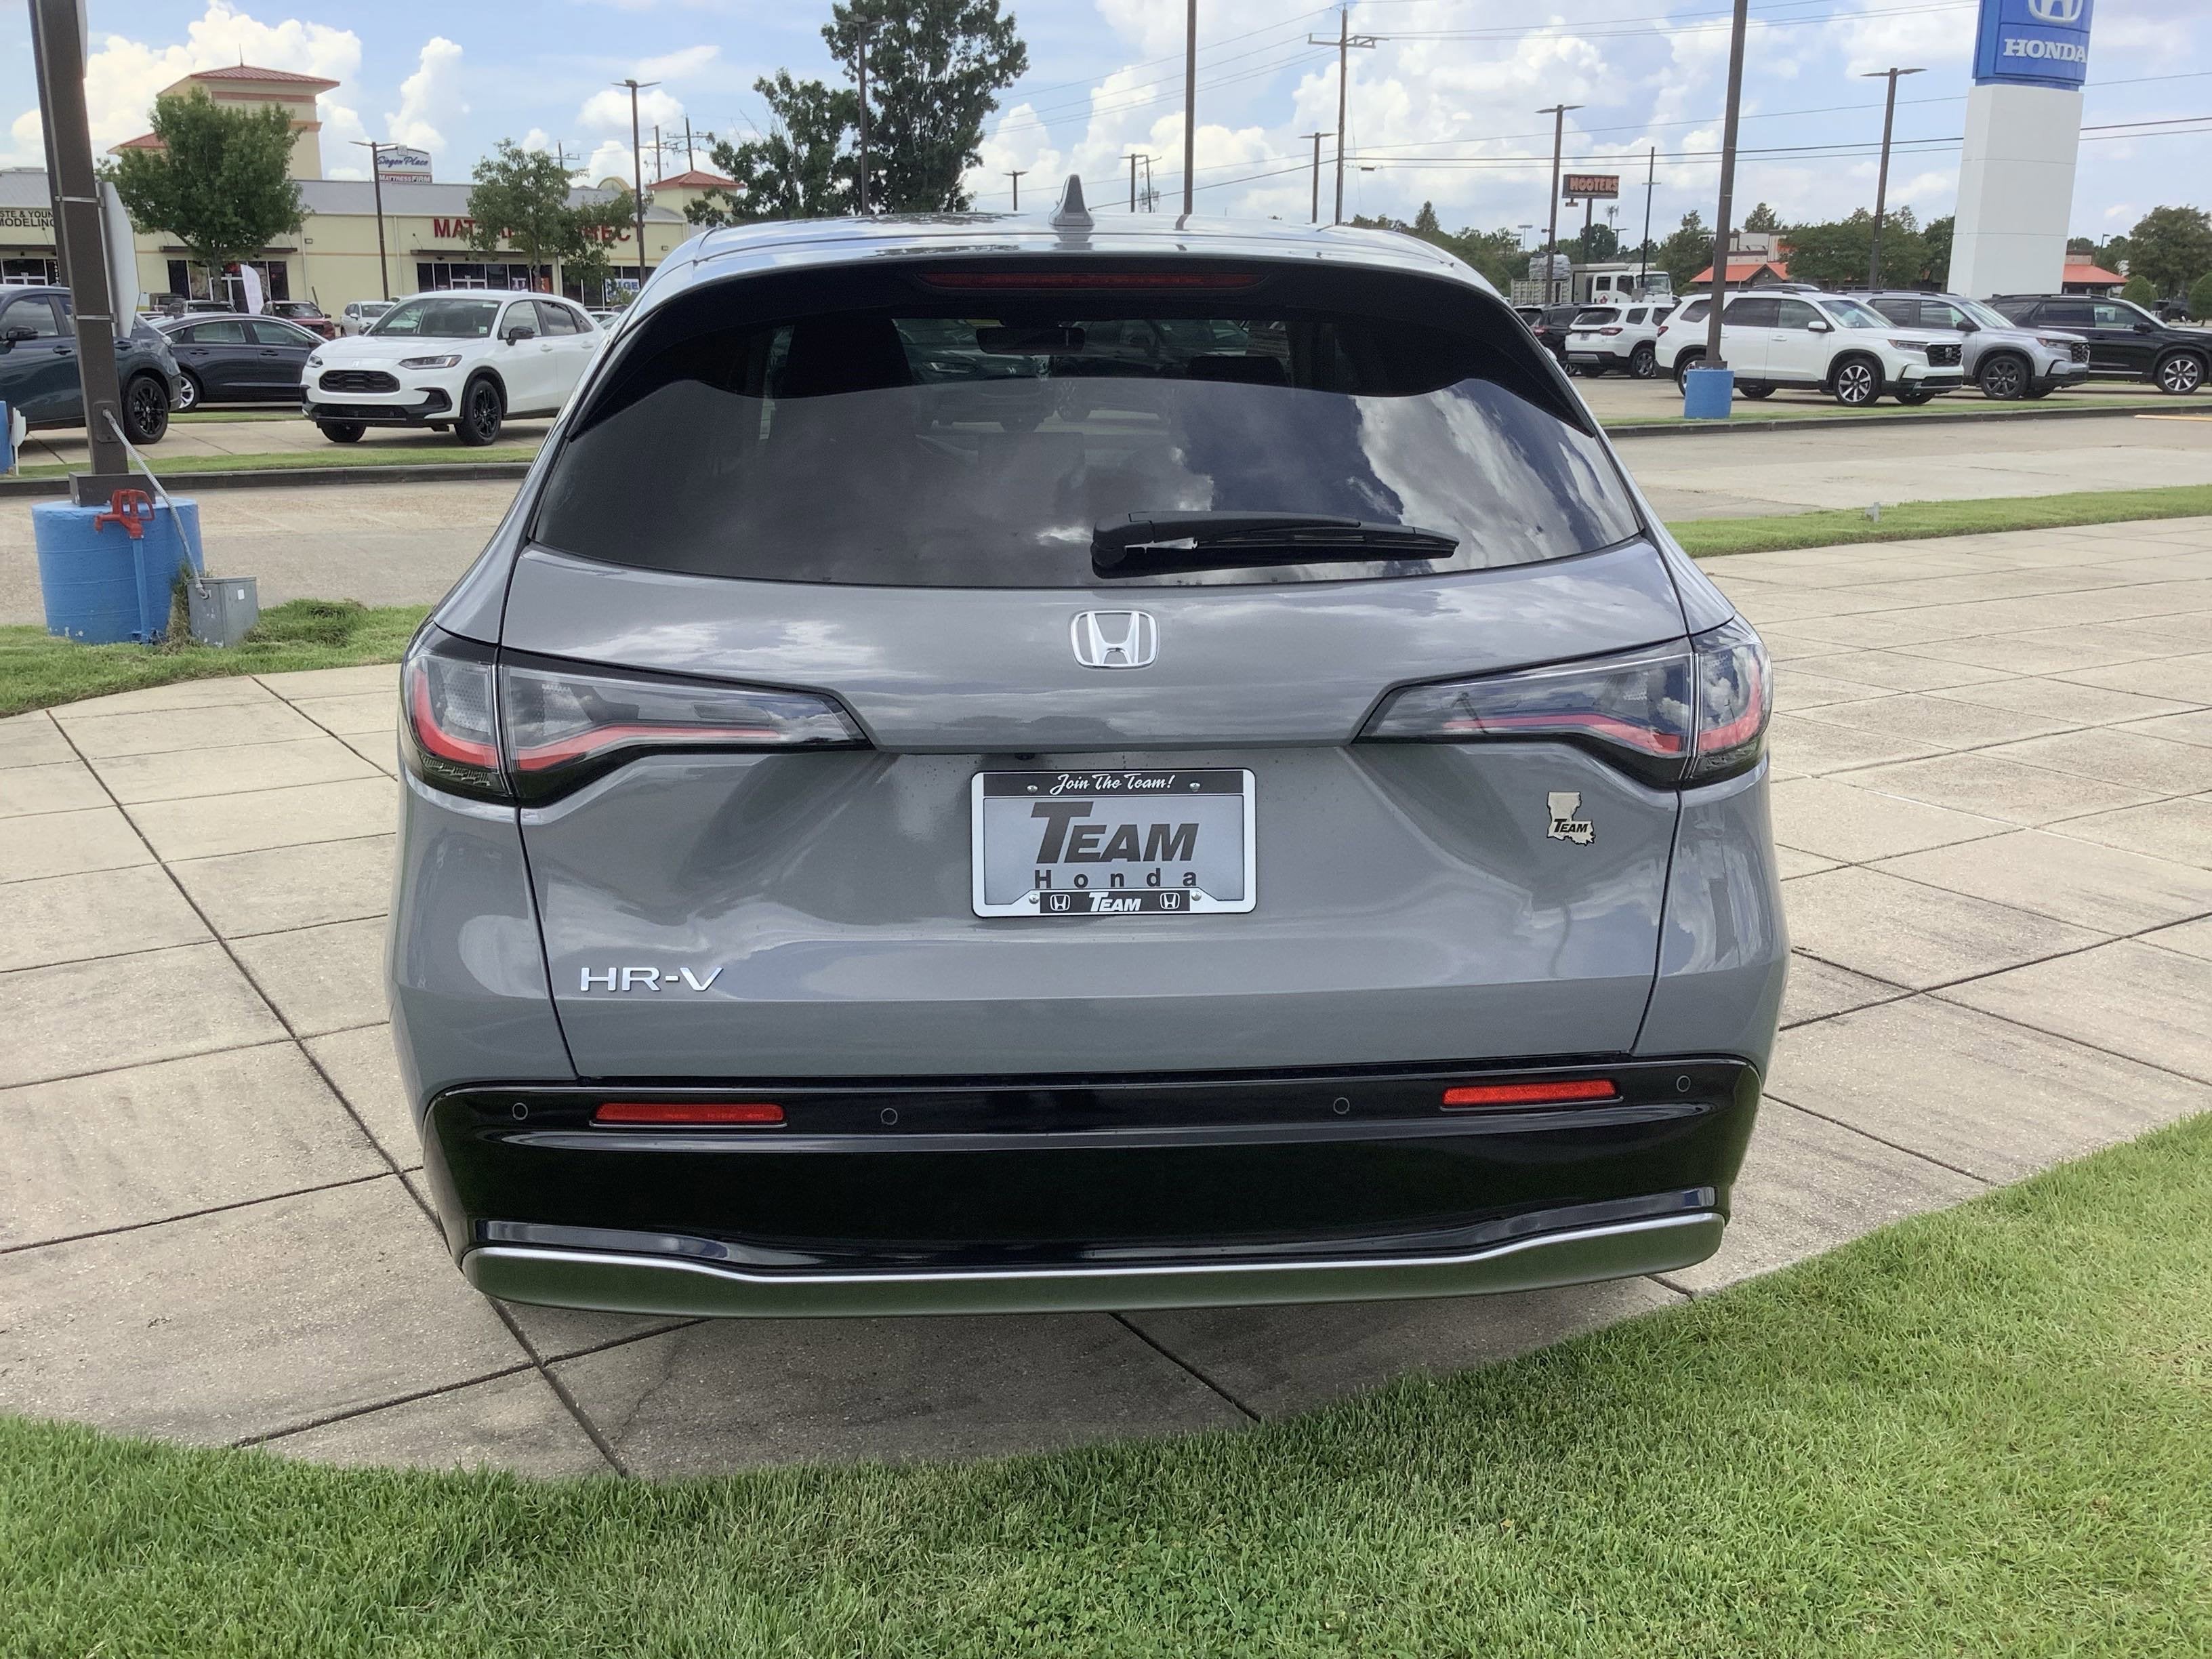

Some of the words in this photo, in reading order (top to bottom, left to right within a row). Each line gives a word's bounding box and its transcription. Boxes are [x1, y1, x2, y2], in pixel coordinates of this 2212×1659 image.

[2003, 39, 2087, 64] HONDA
[1570, 177, 1618, 192] HOOTERS
[1050, 774, 1090, 795] Join
[1092, 774, 1122, 789] The
[1124, 775, 1175, 789] Team!
[1030, 801, 1200, 864] TEAM
[1554, 818, 1589, 833] TEAM
[1035, 868, 1197, 889] Honda
[1088, 892, 1142, 912] TEAM
[580, 967, 724, 991] HR-V
